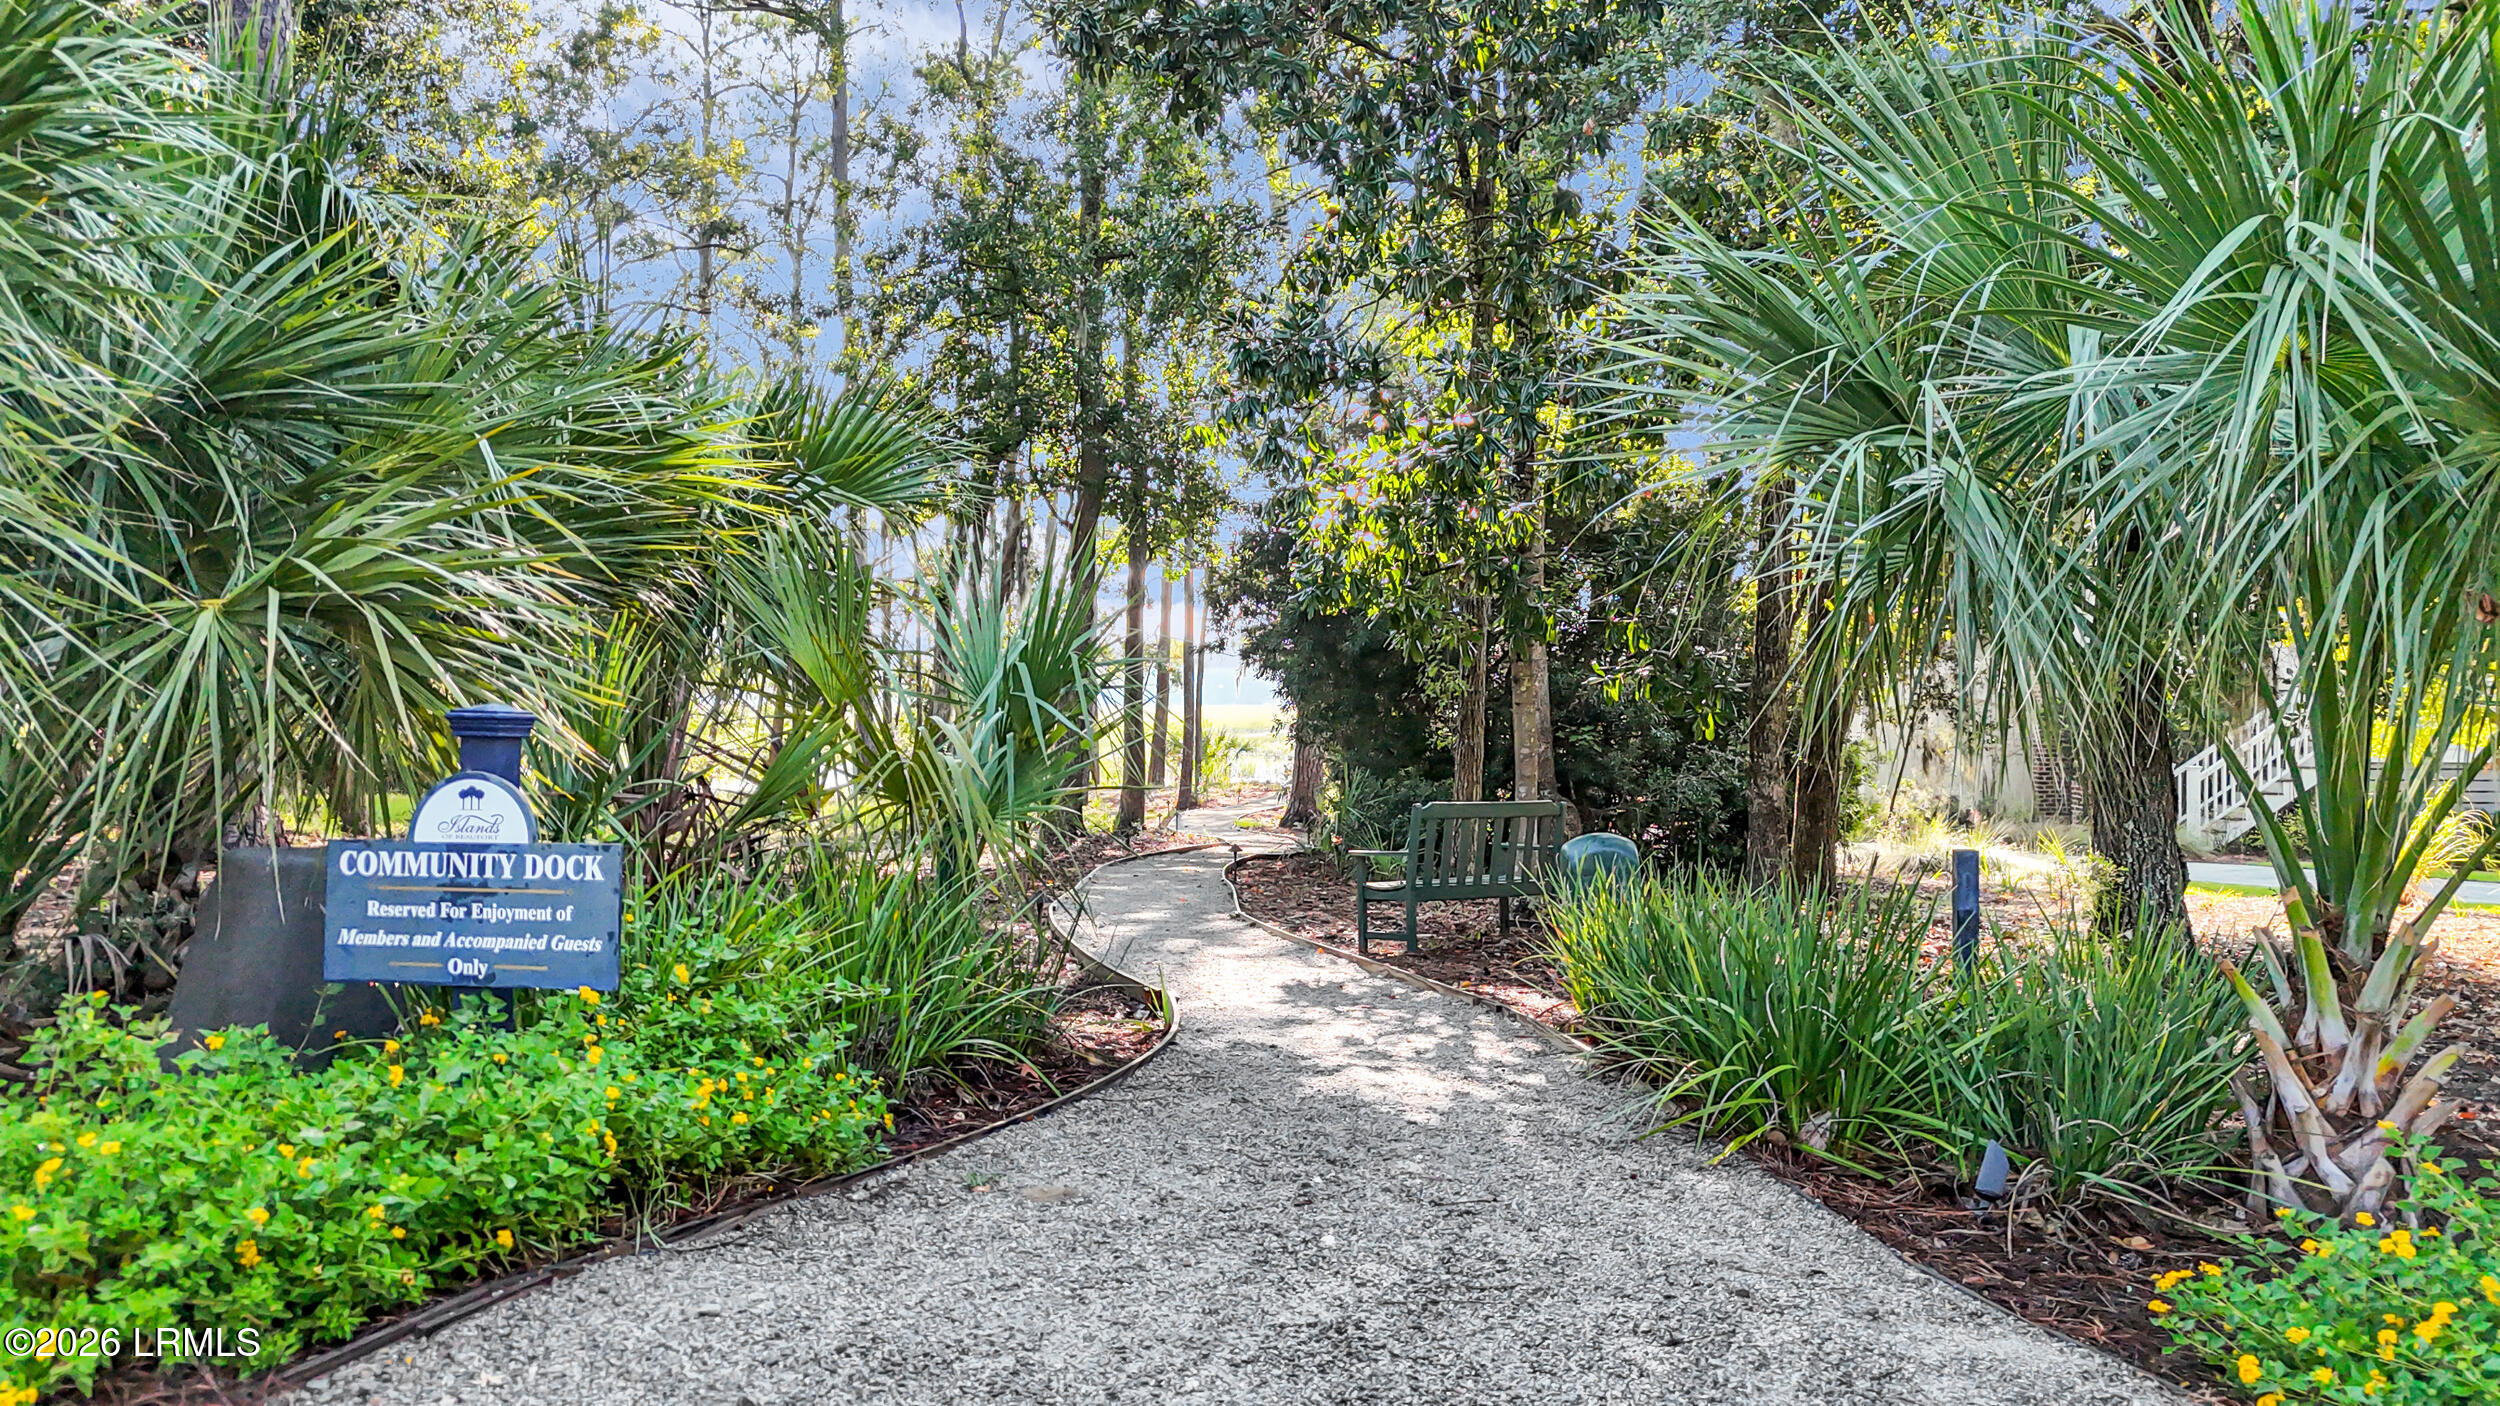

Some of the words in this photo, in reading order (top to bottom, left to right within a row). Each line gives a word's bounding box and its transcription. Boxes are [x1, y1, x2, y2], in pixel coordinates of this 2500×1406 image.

[437, 813, 505, 834] Islands
[339, 850, 517, 880] COMMUNITY
[523, 854, 604, 881] DOCK
[366, 900, 436, 918] Reserved
[440, 902, 468, 918] For
[471, 903, 552, 924] Enjoyment
[556, 905, 575, 921] of
[337, 928, 409, 947] Members
[411, 931, 443, 948] and
[444, 933, 547, 953] Accompanied
[550, 935, 603, 952] Guests
[447, 957, 488, 979] Only
